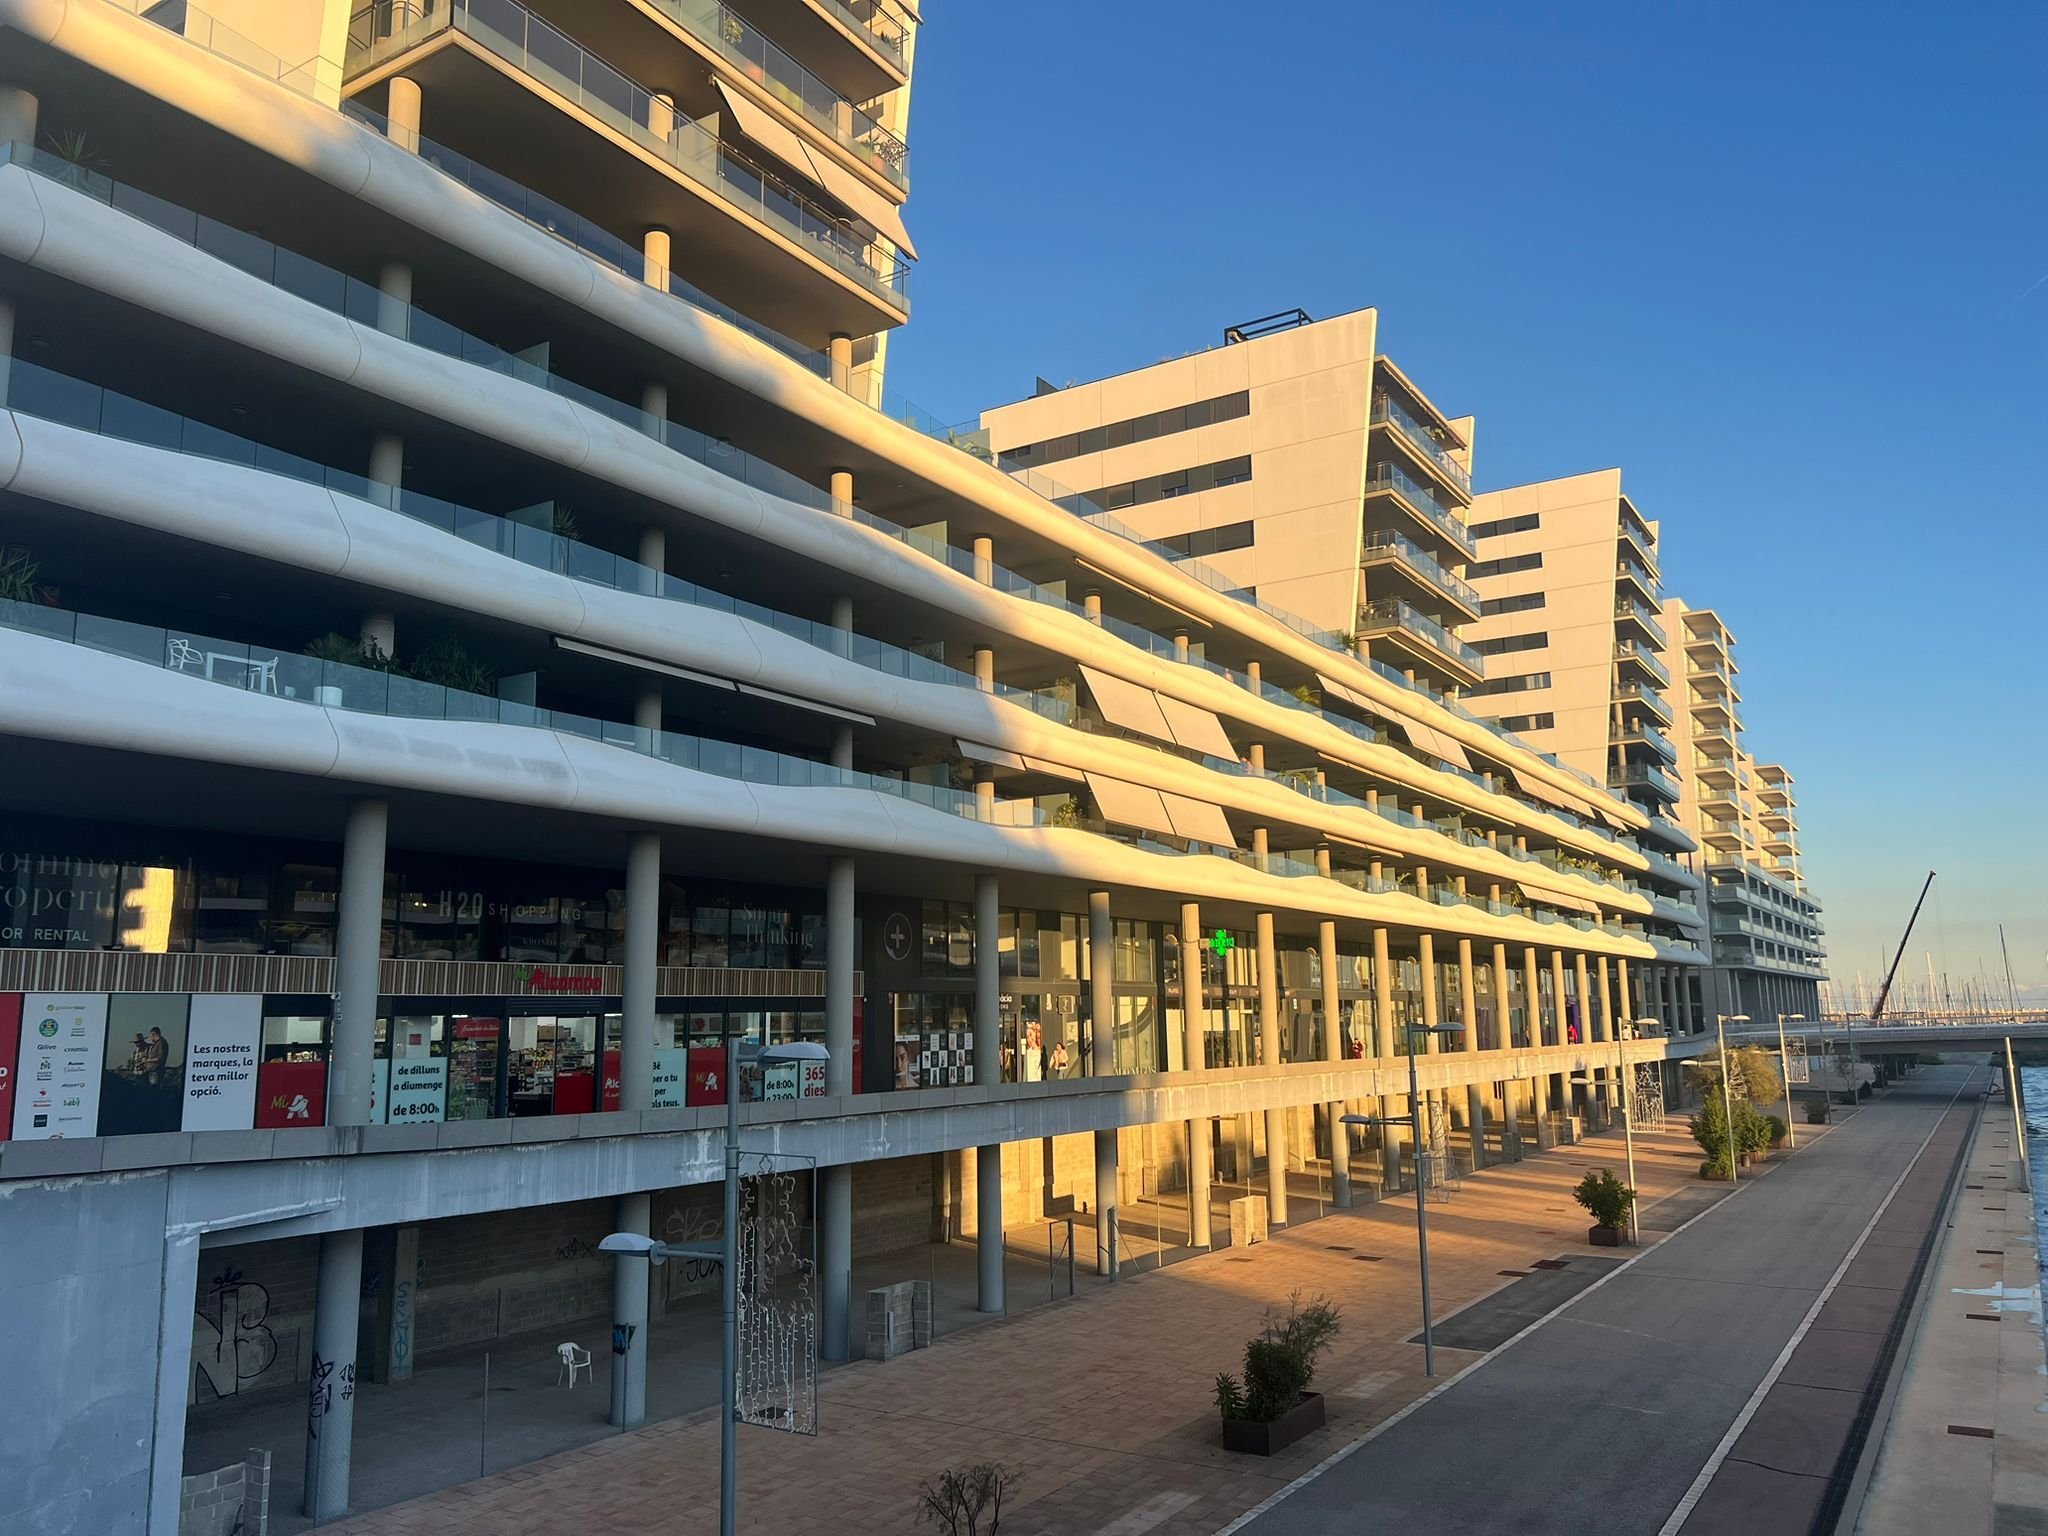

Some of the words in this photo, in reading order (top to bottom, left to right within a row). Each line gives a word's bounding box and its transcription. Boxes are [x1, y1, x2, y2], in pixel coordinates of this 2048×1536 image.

[488, 903, 581, 921] SHOPPING
[34, 927, 91, 942] RENTAL
[529, 968, 601, 992] Alcampo
[194, 1044, 210, 1054] Les
[213, 1044, 251, 1054] nostres
[192, 1058, 241, 1070] marques,
[243, 1056, 253, 1066] la
[397, 1066, 409, 1075] de
[410, 1065, 440, 1075] dilluns
[191, 1073, 215, 1082] teva
[217, 1071, 249, 1081] millor
[804, 1066, 825, 1081] 365
[190, 1085, 222, 1099] opció.
[400, 1081, 443, 1092] diumenge
[654, 1087, 667, 1098] per
[766, 1081, 775, 1090] de
[804, 1083, 825, 1097] dies
[393, 1104, 407, 1116] de
[409, 1102, 440, 1115] 8:00h
[662, 1099, 680, 1107] teus.
